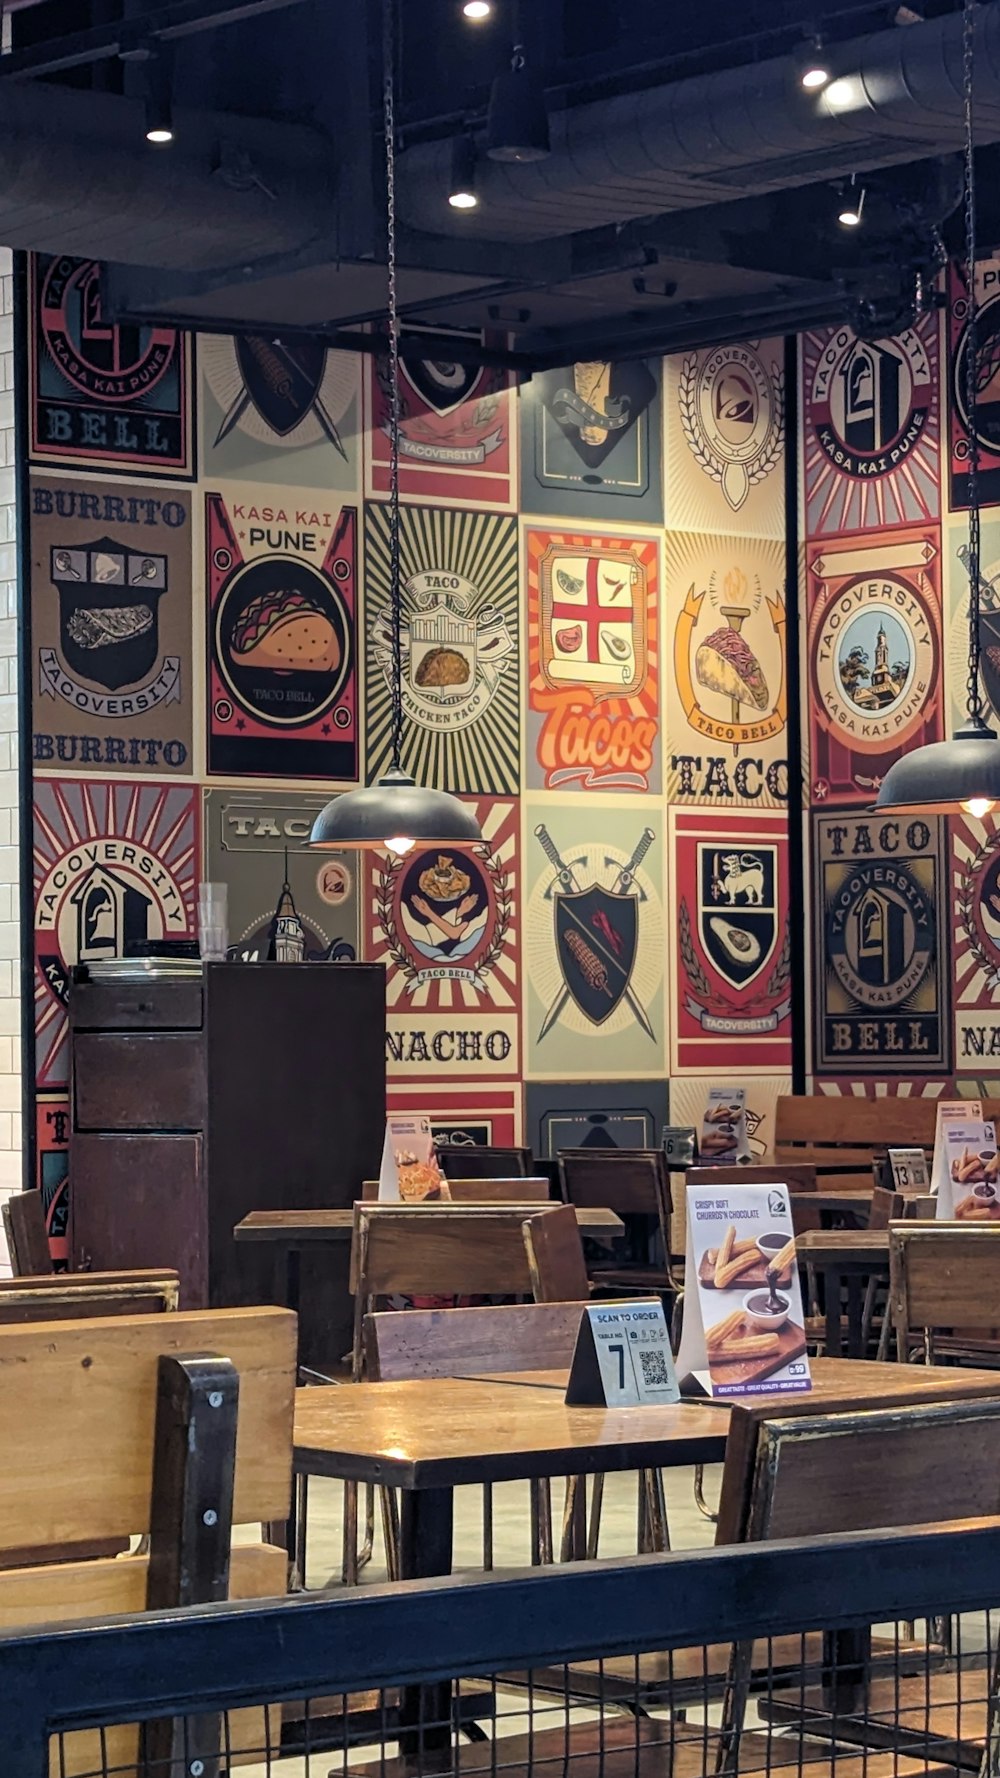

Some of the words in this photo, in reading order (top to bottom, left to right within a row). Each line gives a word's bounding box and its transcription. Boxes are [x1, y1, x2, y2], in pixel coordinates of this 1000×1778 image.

[54, 338, 88, 383] KASA
[94, 379, 126, 393] KAI
[131, 350, 166, 389] PUNE
[702, 350, 768, 400] TACOVERSITY
[46, 408, 168, 451] BELL
[820, 431, 852, 472] KASA
[857, 460, 887, 475] KAI
[890, 413, 924, 463] PUNE
[403, 442, 481, 460] TACOVERSITY
[32, 487, 187, 528] BURRITO
[233, 504, 288, 523] KASA
[295, 510, 332, 528] KAI
[249, 527, 317, 552] PUNE
[424, 575, 460, 589] TACO
[819, 582, 931, 663] TACOVERSITY
[43, 652, 177, 714] TACOVERSITY
[252, 688, 285, 701] TACO
[286, 690, 315, 703] BELL
[400, 691, 452, 724] CHICKEN
[453, 695, 481, 722] TACO
[825, 691, 856, 732] KASA
[862, 723, 890, 736] KAI
[894, 682, 927, 729] PUNE
[530, 687, 658, 771] Tacos
[697, 717, 736, 740] TACO
[741, 721, 778, 741] BELL
[32, 733, 188, 767] BURRITO
[671, 754, 789, 800] TACO
[228, 816, 311, 838] TAC
[827, 821, 931, 856] TACO
[39, 843, 183, 926] TACOVERSITY
[832, 868, 928, 933] TACOVERSITY
[420, 968, 446, 980] TACO
[448, 969, 472, 980] BELL
[837, 961, 864, 998] KASA
[868, 991, 893, 1002] KAI
[896, 960, 924, 997] PUNE
[705, 1017, 774, 1030] TACOVERSITY
[832, 1022, 929, 1051] BELL
[385, 1030, 512, 1063] NACHO
[662, 1139, 675, 1154] 16
[894, 1166, 909, 1186] 13
[715, 1199, 729, 1209] SOFT
[728, 1209, 760, 1220] CHOCOLATE
[597, 1314, 620, 1323] SCAN
[620, 1313, 631, 1321] TO
[632, 1311, 659, 1321] ORDER
[608, 1344, 625, 1390] 7
